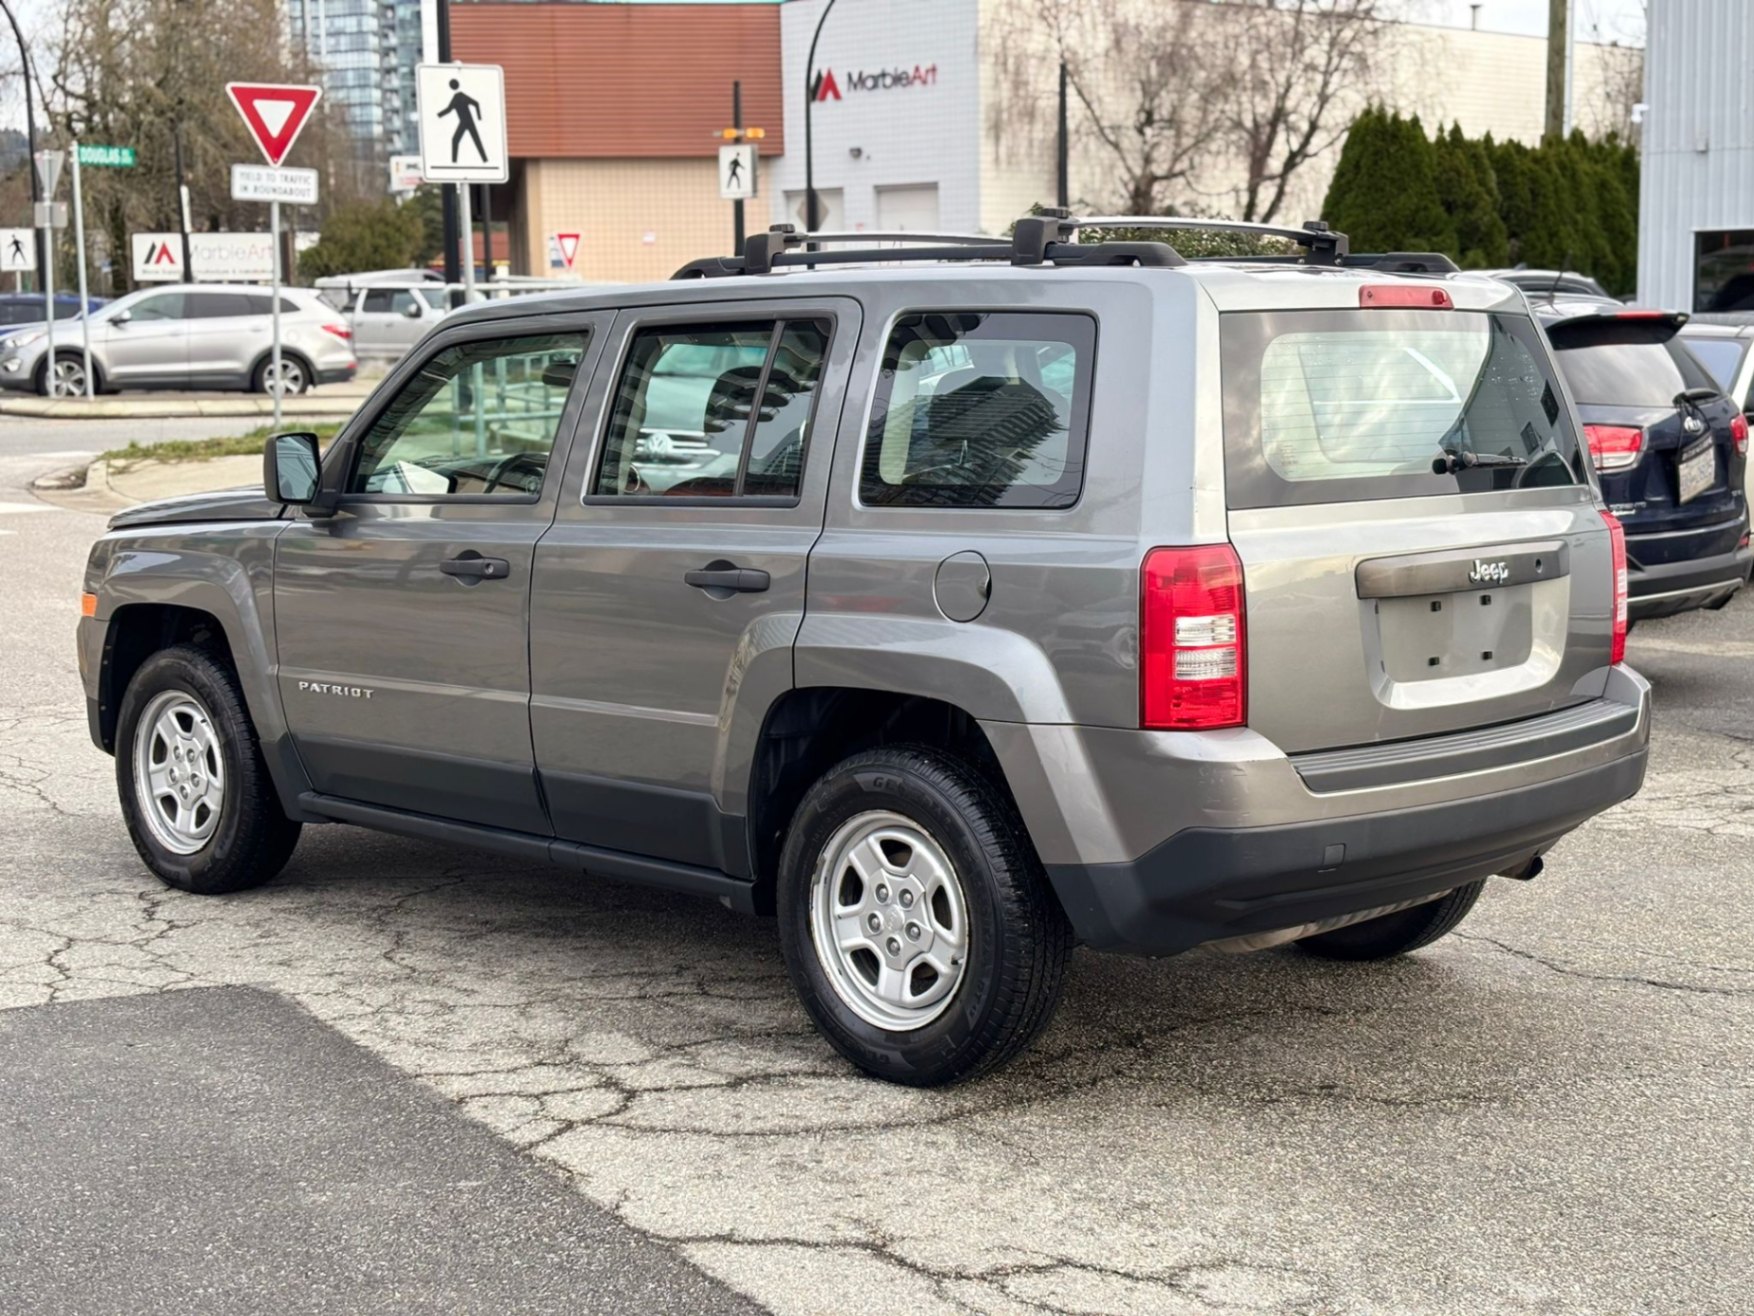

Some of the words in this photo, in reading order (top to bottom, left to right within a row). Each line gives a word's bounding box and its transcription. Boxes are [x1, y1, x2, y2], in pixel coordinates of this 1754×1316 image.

[847, 63, 937, 91] MarbleArt
[265, 172, 277, 183] TO
[280, 173, 312, 187] TRAFFIC
[253, 185, 312, 198] ROUNDABOUT
[1469, 559, 1509, 584] Jeep
[298, 681, 374, 699] PATRIOT
